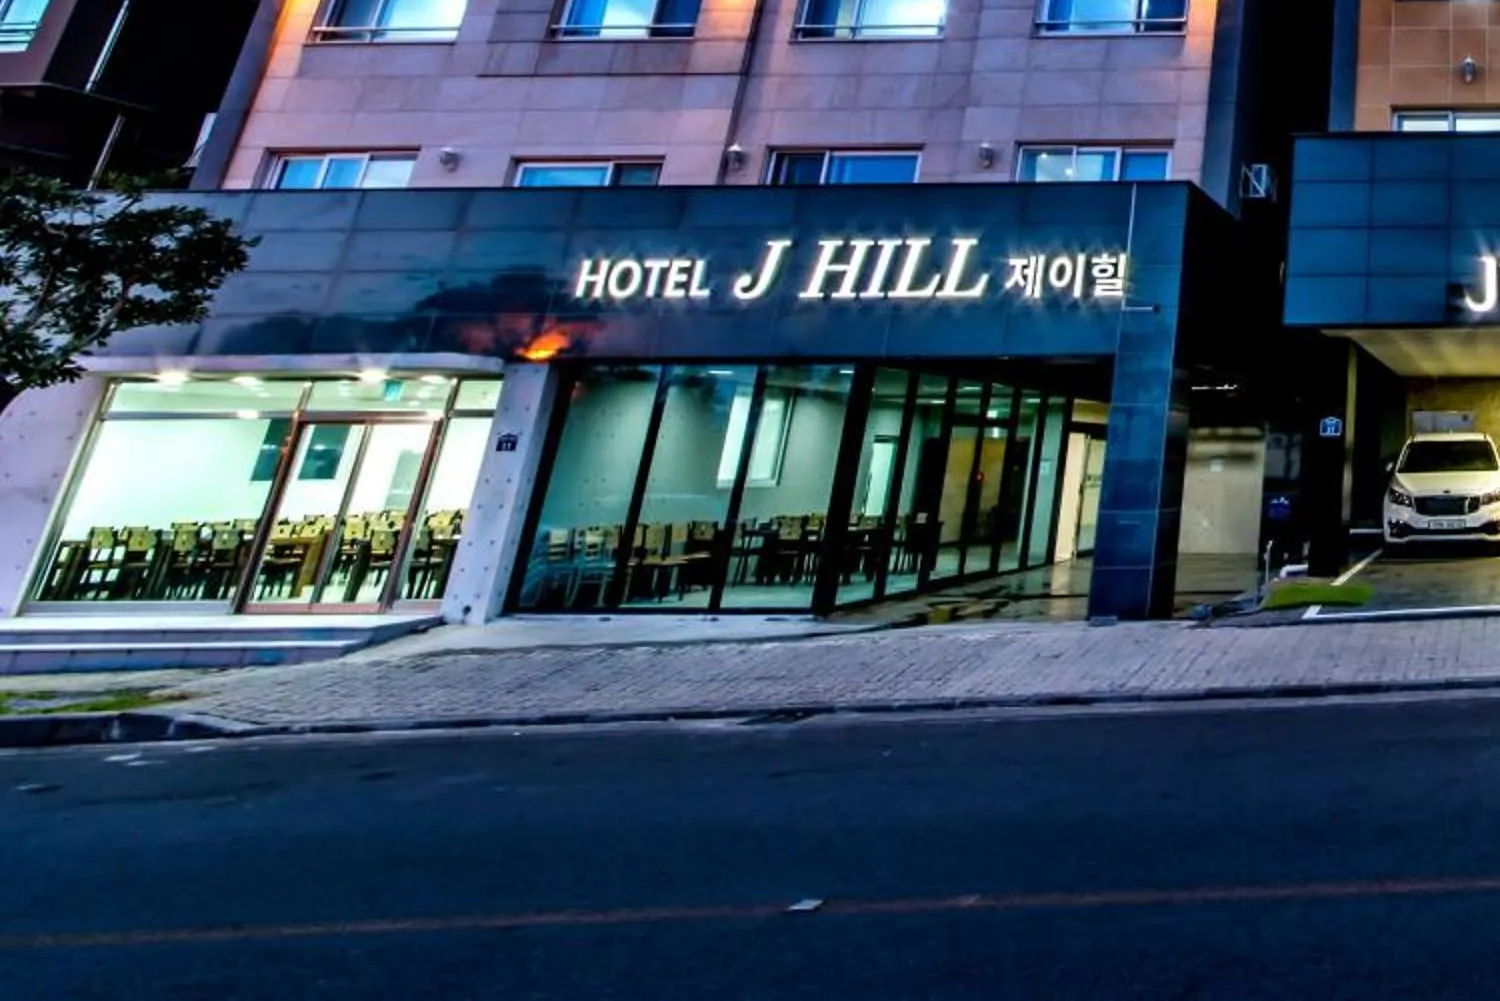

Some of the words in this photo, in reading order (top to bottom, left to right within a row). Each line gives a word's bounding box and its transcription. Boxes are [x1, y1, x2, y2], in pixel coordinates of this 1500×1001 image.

[575, 259, 710, 299] HOTEL
[732, 239, 792, 300] J
[798, 237, 989, 299] HILL
[1004, 252, 1127, 299] 제이힐
